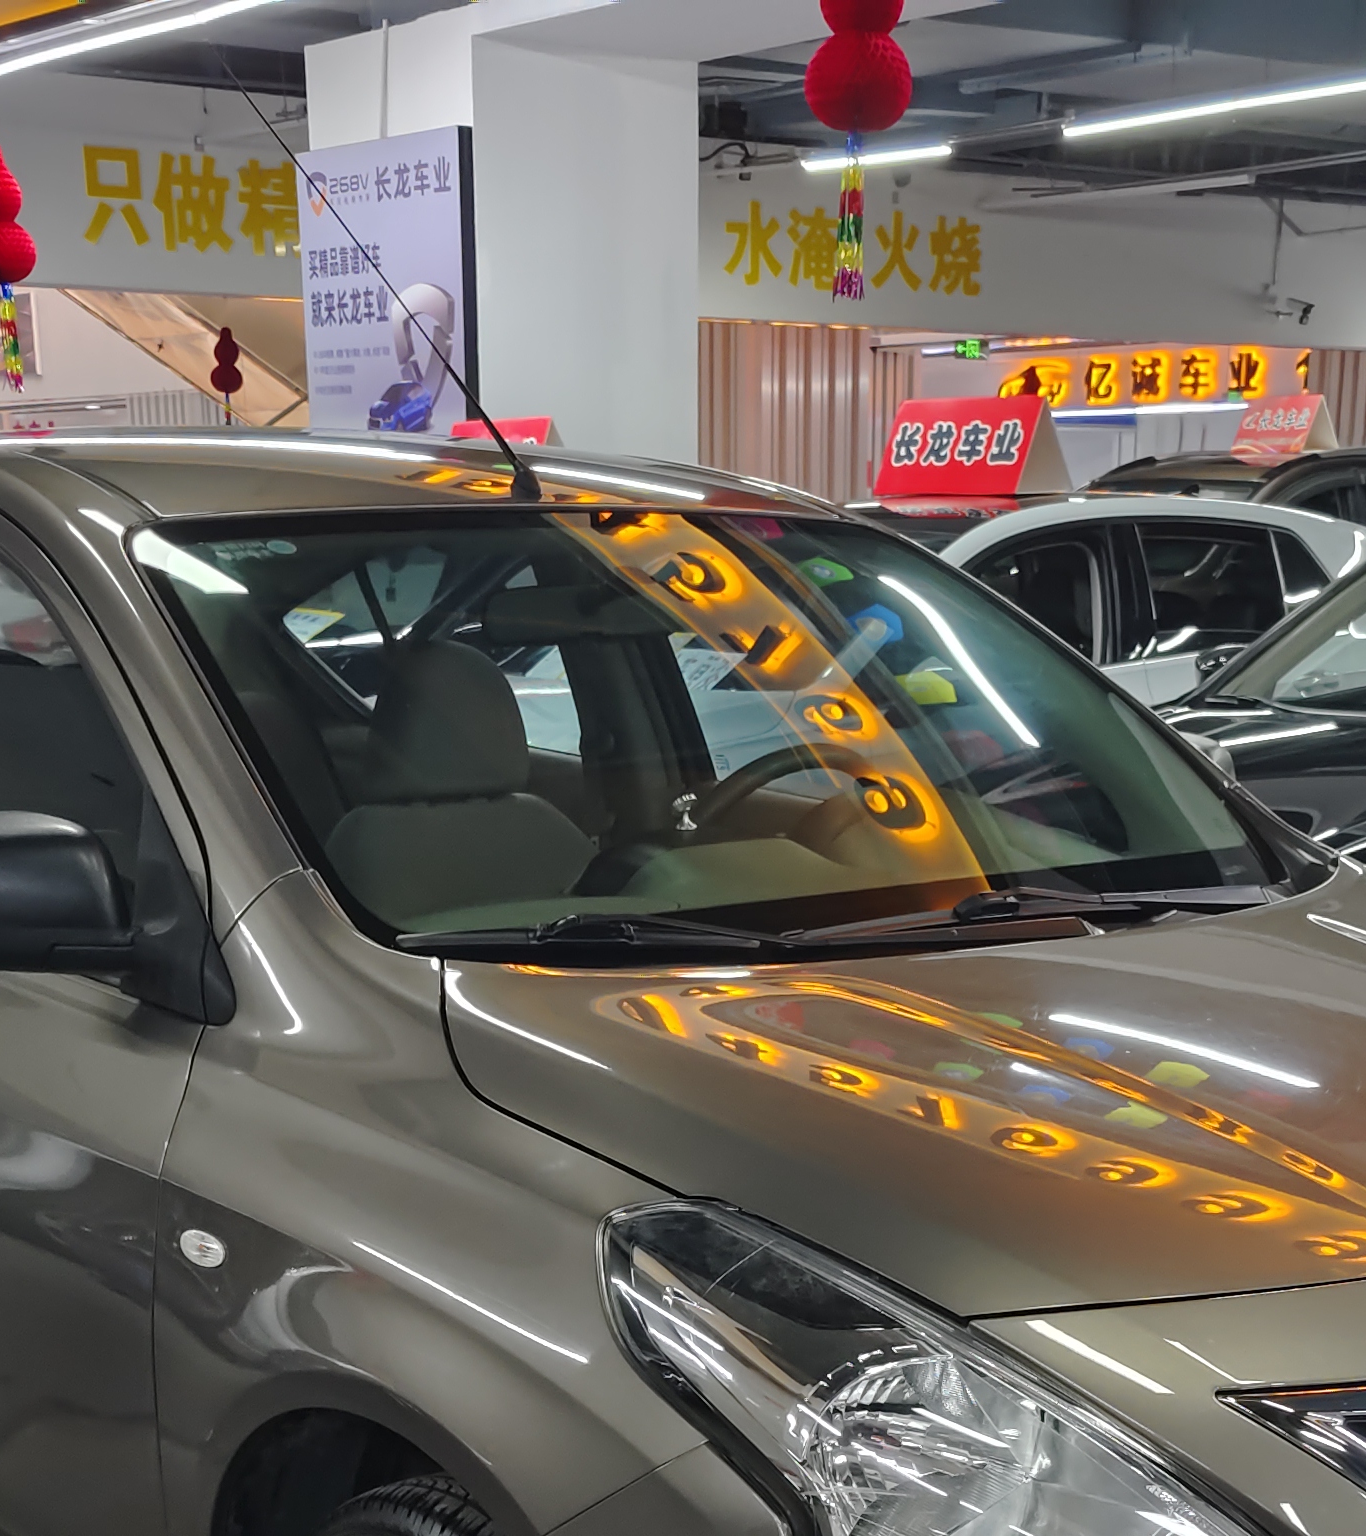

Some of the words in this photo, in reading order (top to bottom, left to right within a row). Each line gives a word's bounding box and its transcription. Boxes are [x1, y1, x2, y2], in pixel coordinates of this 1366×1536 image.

[329, 173, 369, 195] 268V
[375, 156, 452, 202] 长龙车业
[310, 286, 390, 328] 就来长龙车业
[891, 419, 1024, 467] 长龙车业
